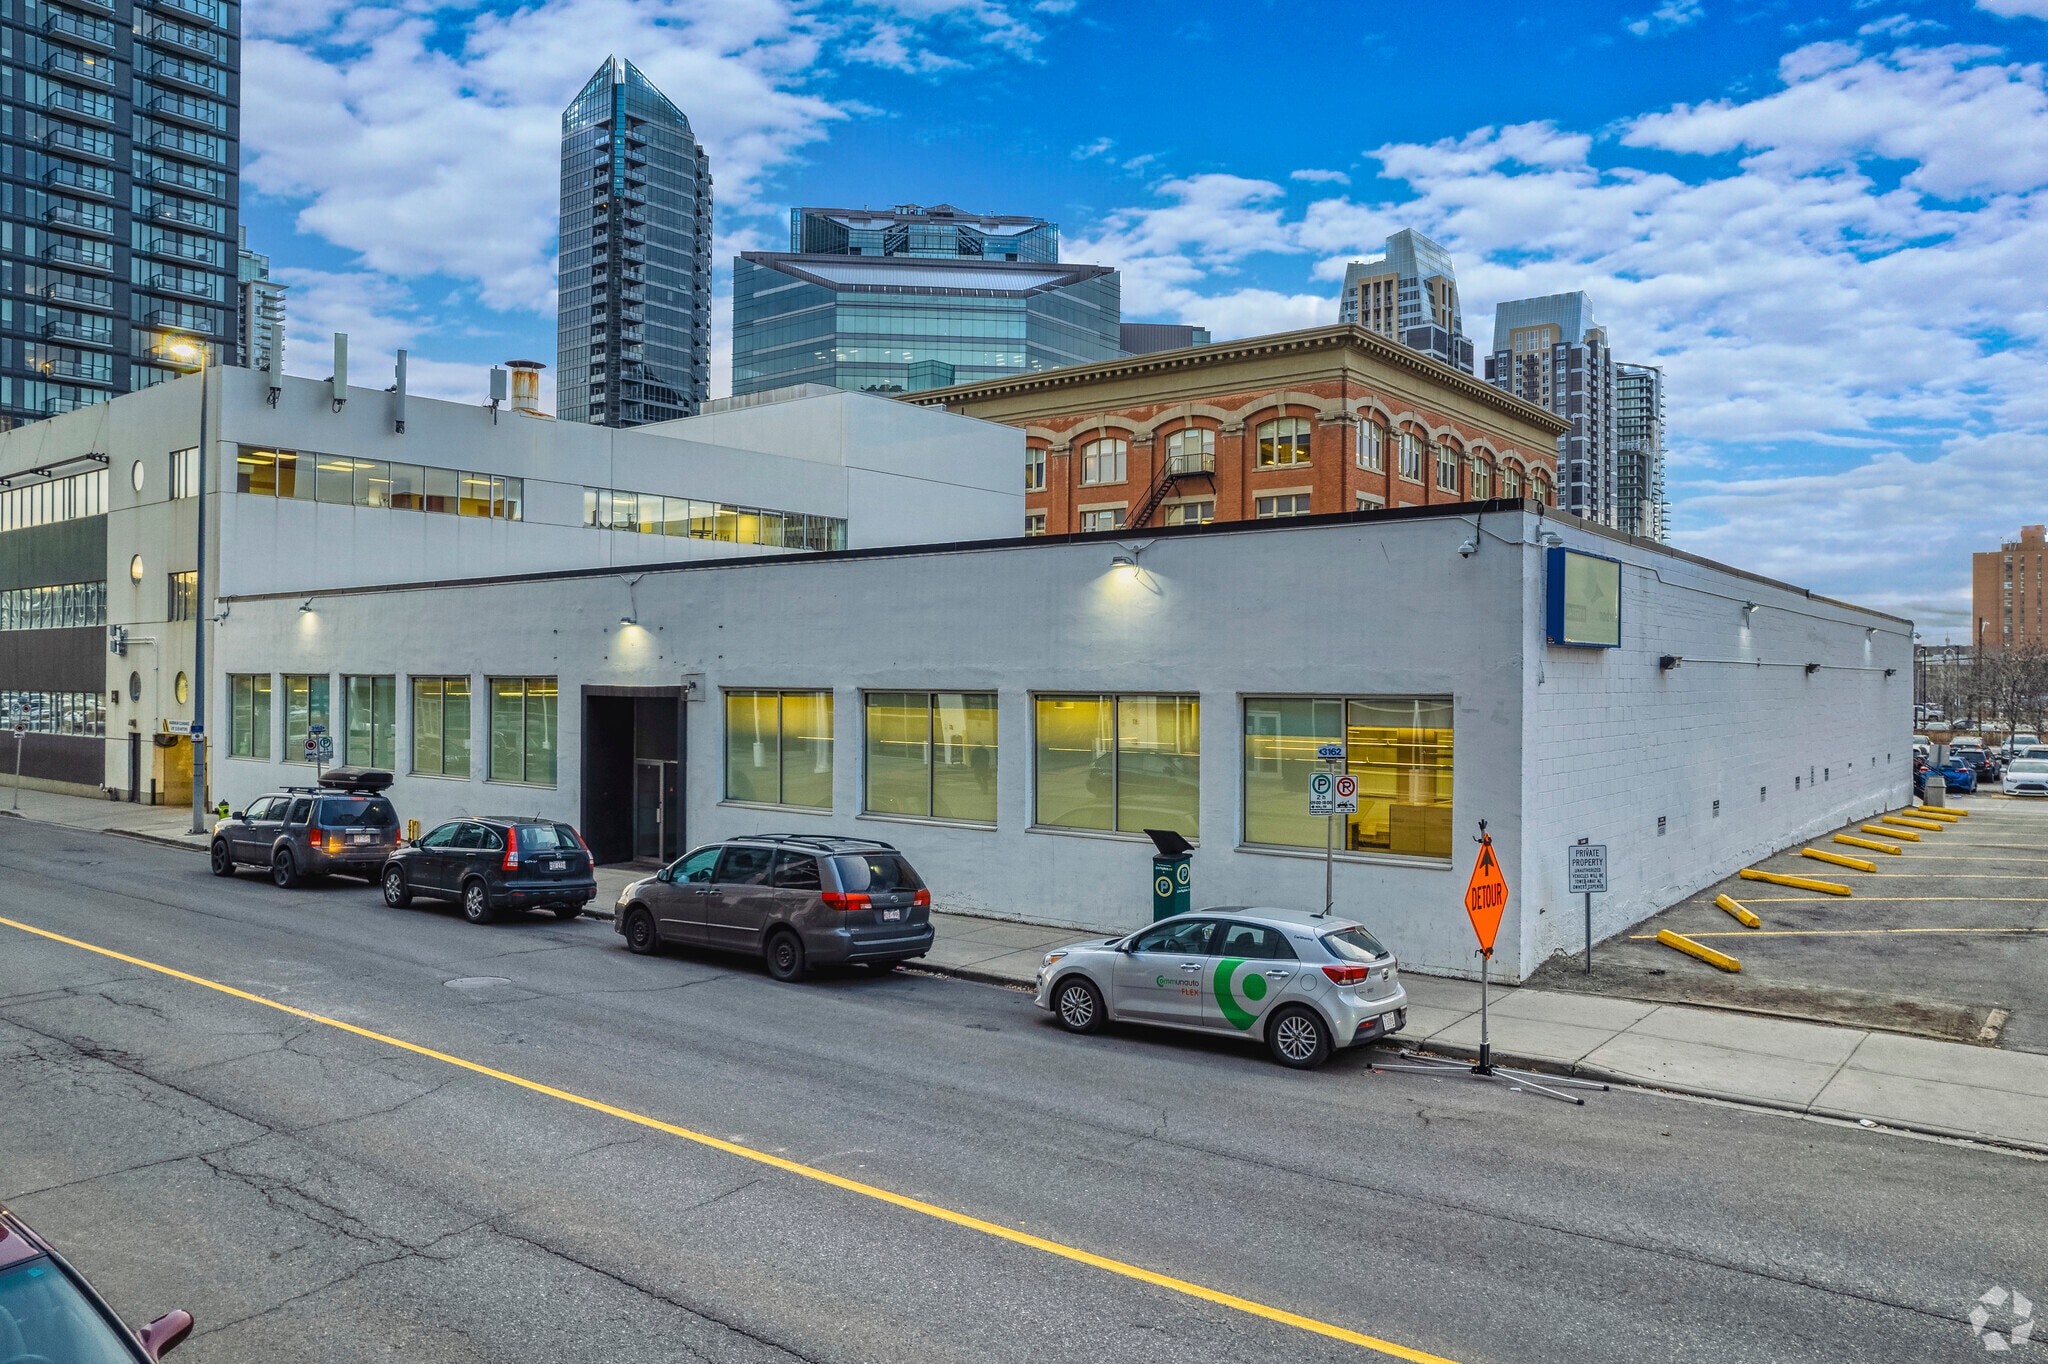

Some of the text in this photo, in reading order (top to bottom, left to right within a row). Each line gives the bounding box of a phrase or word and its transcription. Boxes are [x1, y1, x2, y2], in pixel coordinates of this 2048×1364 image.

[1322, 748, 1342, 756] 3162
[1318, 778, 1327, 790] P
[1575, 849, 1600, 857] PRIVATE
[1572, 858, 1603, 867] PROPERTY
[1471, 883, 1502, 911] DETOUR
[1156, 975, 1200, 987] Communauto
[1181, 988, 1199, 997] FLEX
